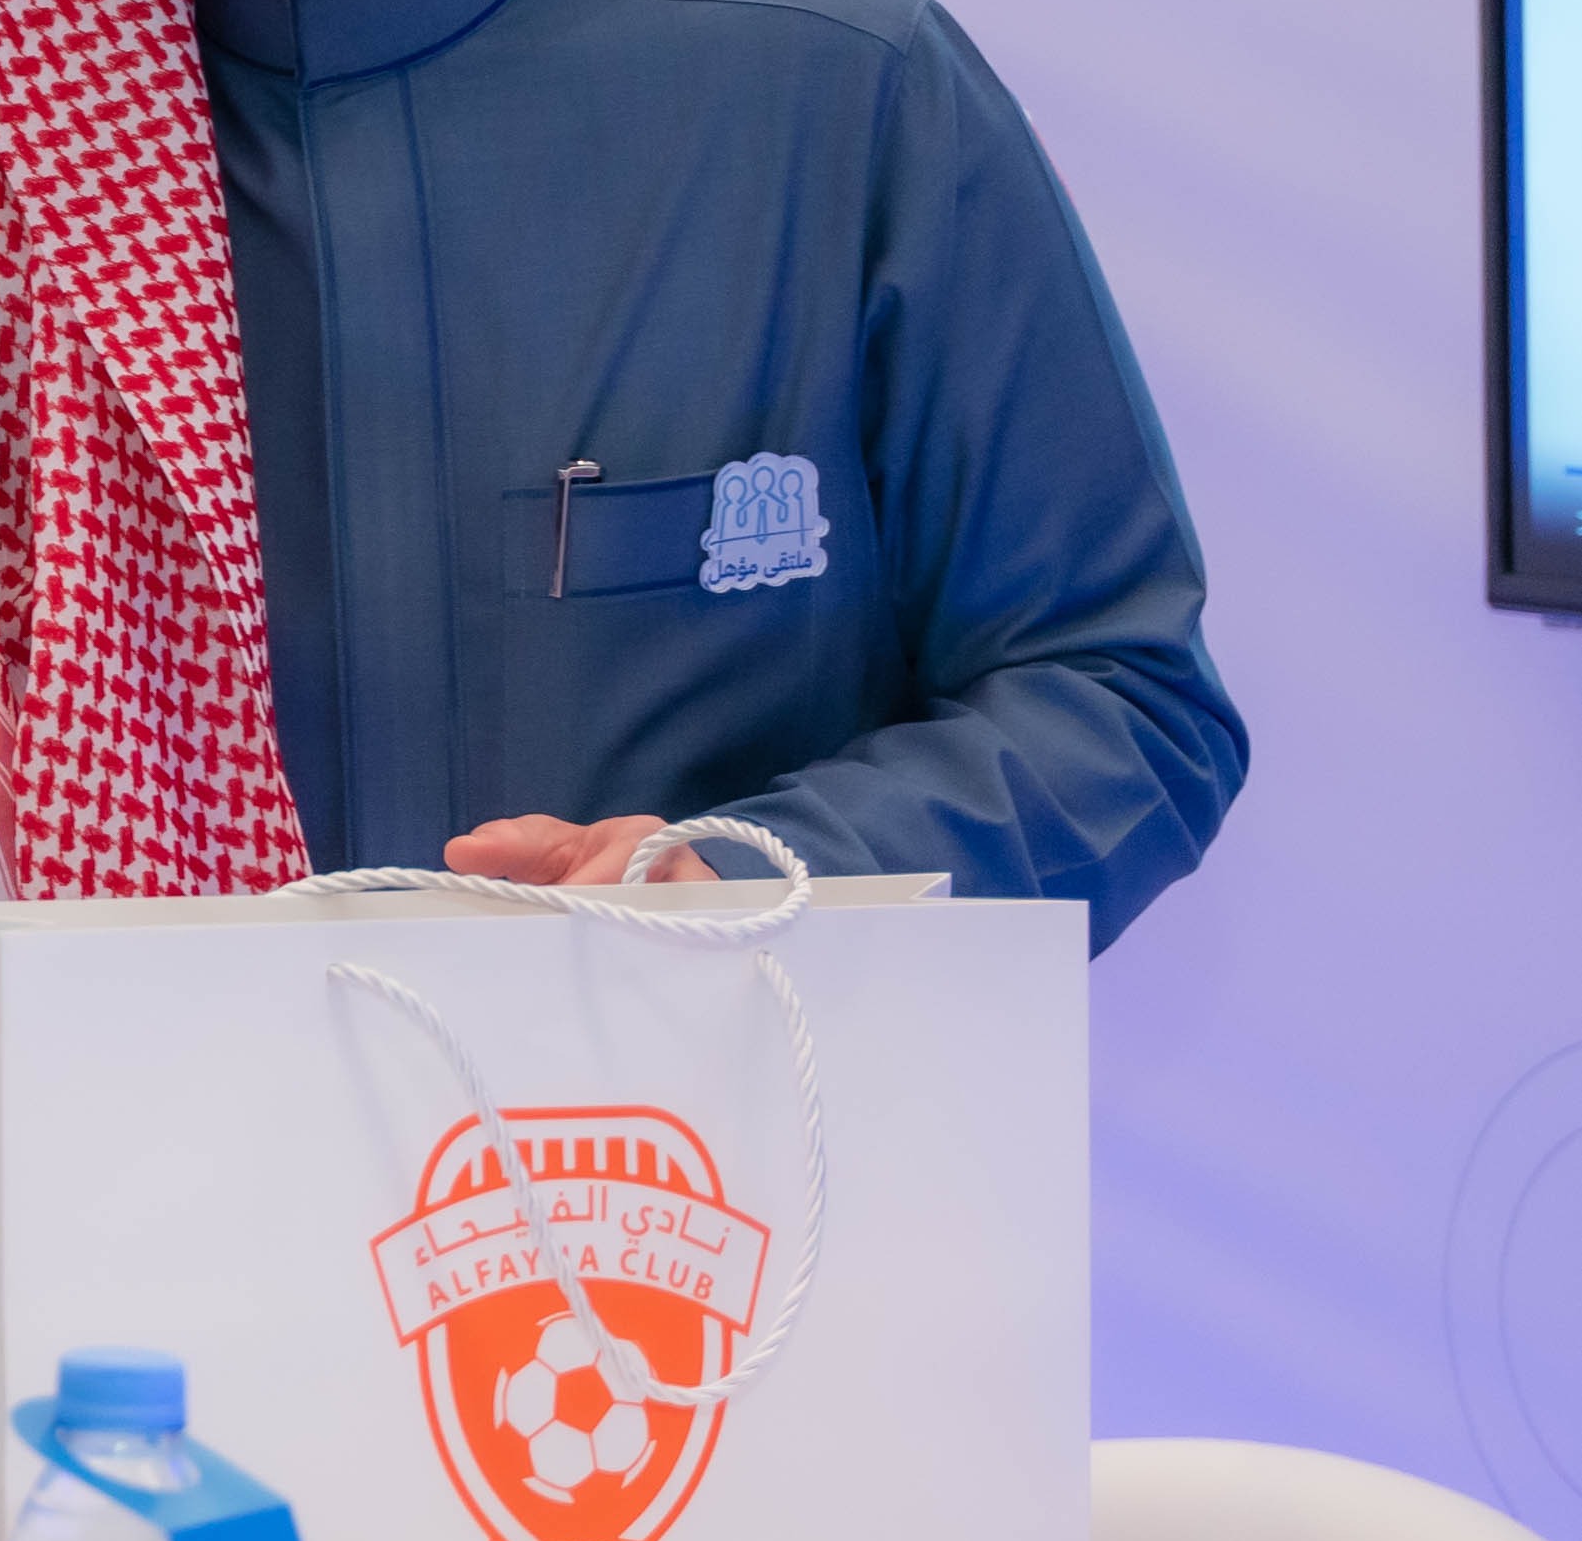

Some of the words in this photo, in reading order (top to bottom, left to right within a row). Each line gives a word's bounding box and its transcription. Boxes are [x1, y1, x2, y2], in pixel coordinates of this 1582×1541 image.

[709, 556, 758, 585] مؤهل
[763, 550, 814, 578] ملتقى
[621, 1203, 732, 1256] نادي
[426, 1244, 600, 1311] ALFAYA
[620, 1247, 715, 1302] CLUB
